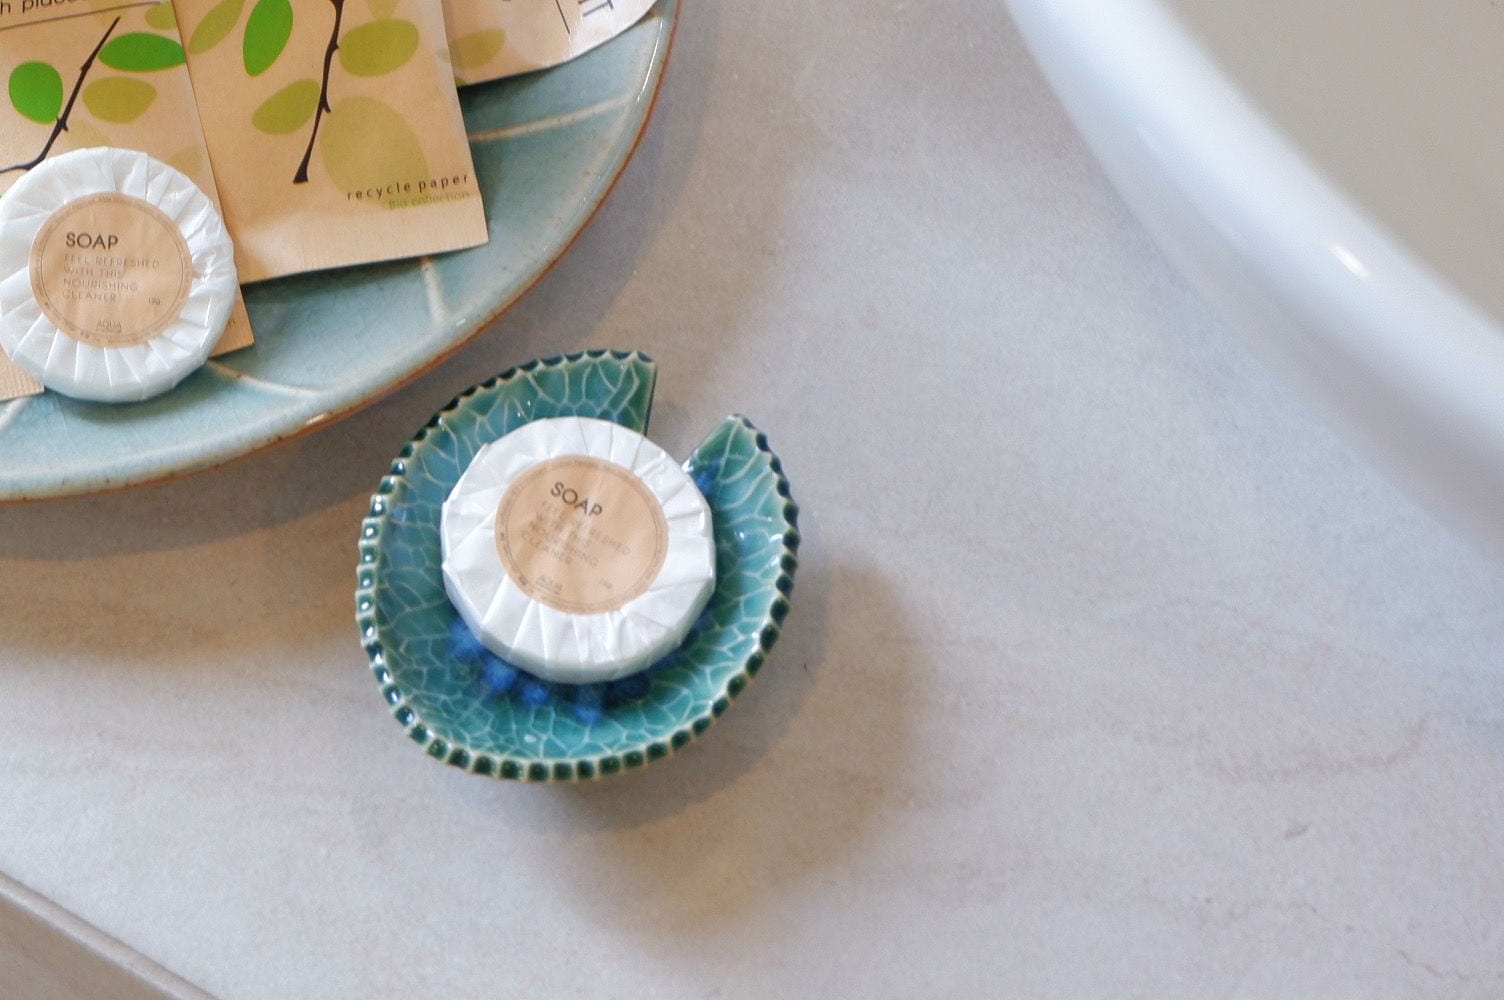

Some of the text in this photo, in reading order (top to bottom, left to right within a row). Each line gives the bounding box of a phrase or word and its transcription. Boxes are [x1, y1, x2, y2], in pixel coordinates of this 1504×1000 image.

[347, 174, 468, 200] recycle paper
[65, 231, 118, 250] SOAP
[550, 481, 603, 517] SOAP
